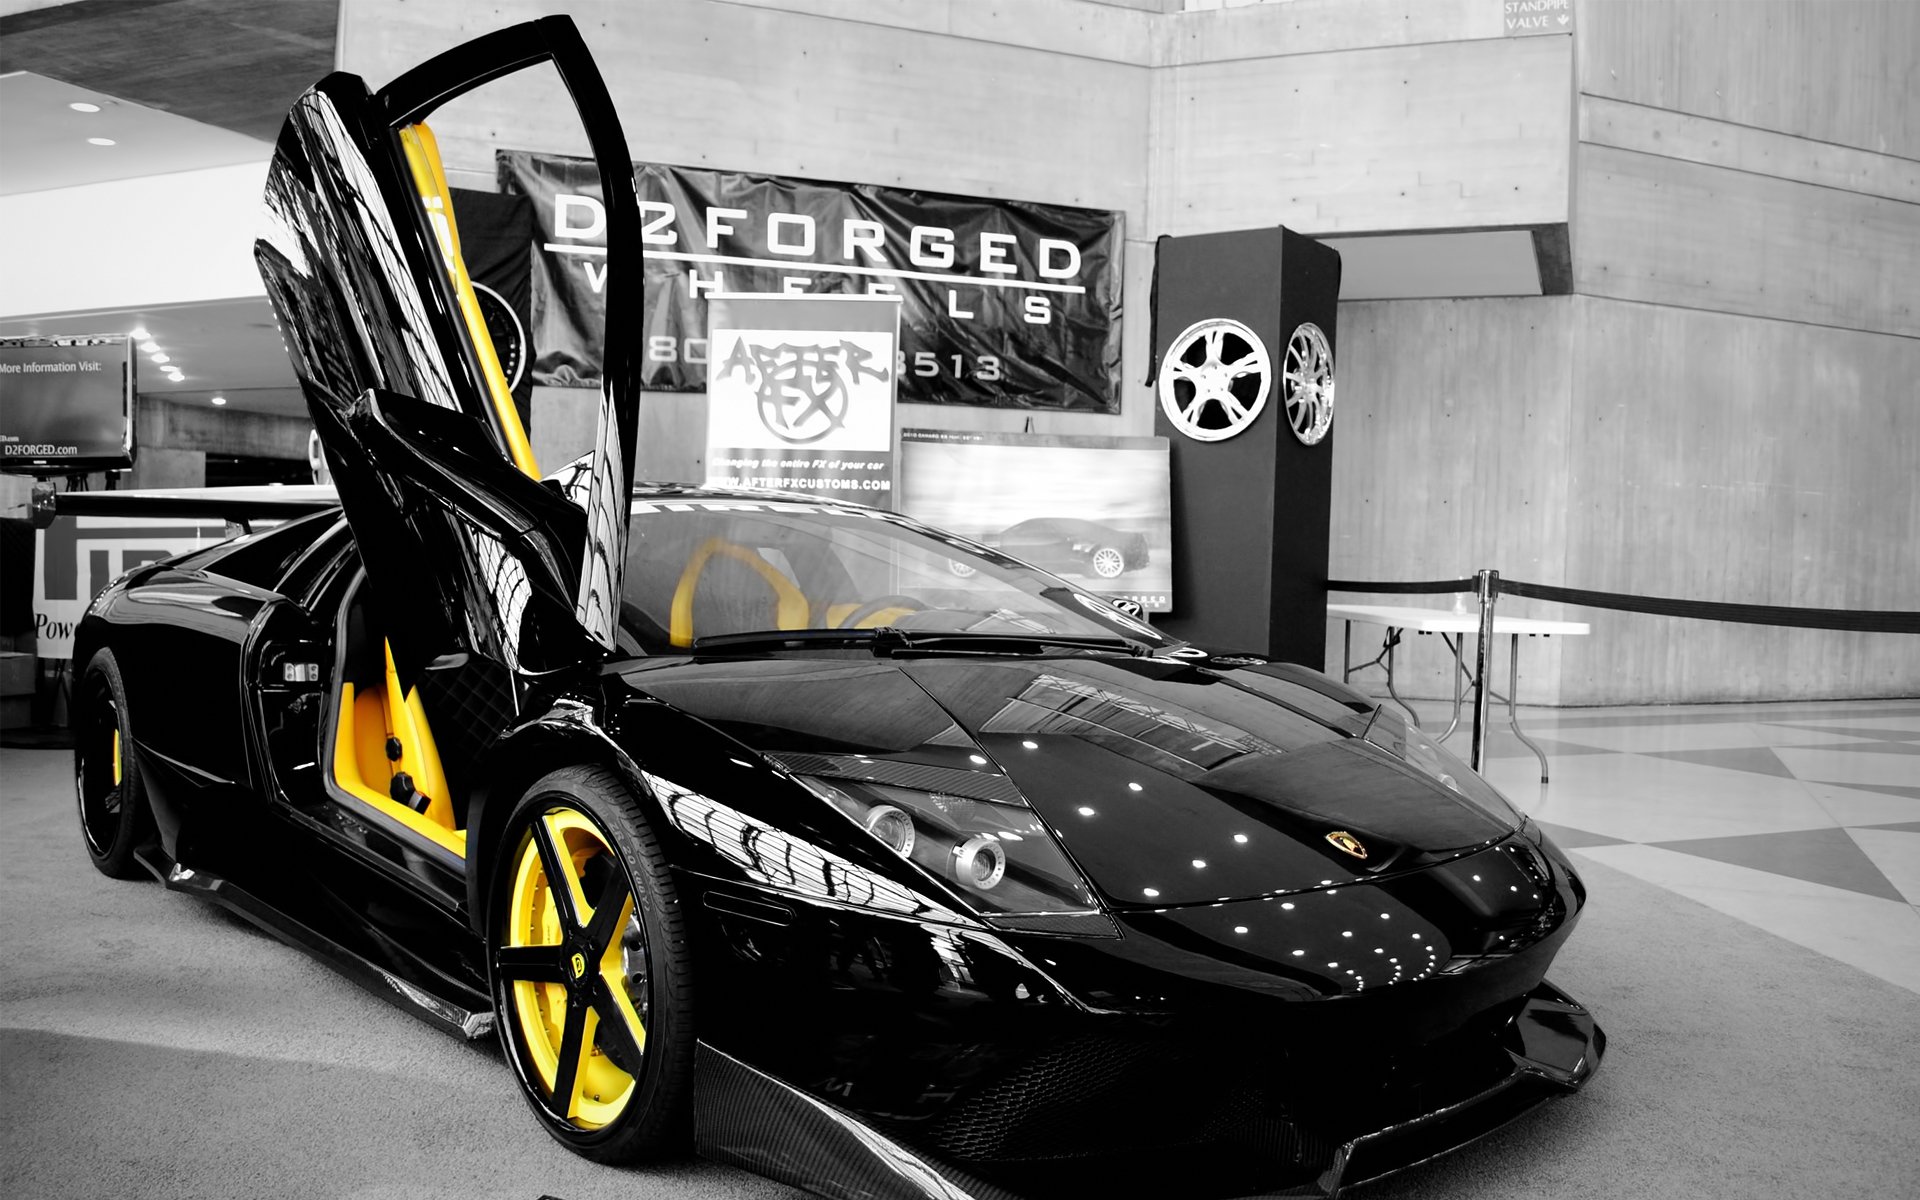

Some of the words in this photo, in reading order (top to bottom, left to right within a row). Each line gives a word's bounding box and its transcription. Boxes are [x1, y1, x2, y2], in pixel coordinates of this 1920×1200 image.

[1505, 0, 1569, 14] STANDPIPE
[1506, 15, 1549, 29] VALVE
[555, 194, 1081, 279] D2FORGED
[0, 363, 21, 373] More
[23, 361, 77, 373] Information
[79, 360, 102, 371] Visit:
[715, 335, 889, 385] AFTER
[755, 372, 846, 431] FX
[5, 444, 78, 455] D2FORGED.com
[761, 459, 778, 467] the
[780, 459, 810, 468] entire
[812, 460, 827, 468] FX
[828, 460, 841, 468] of
[841, 460, 866, 470] your
[867, 462, 885, 470] car
[708, 477, 891, 490] W.AFTERFXCUSTOMS.COM
[35, 613, 76, 640] Pow
[623, 846, 636, 864] 20
